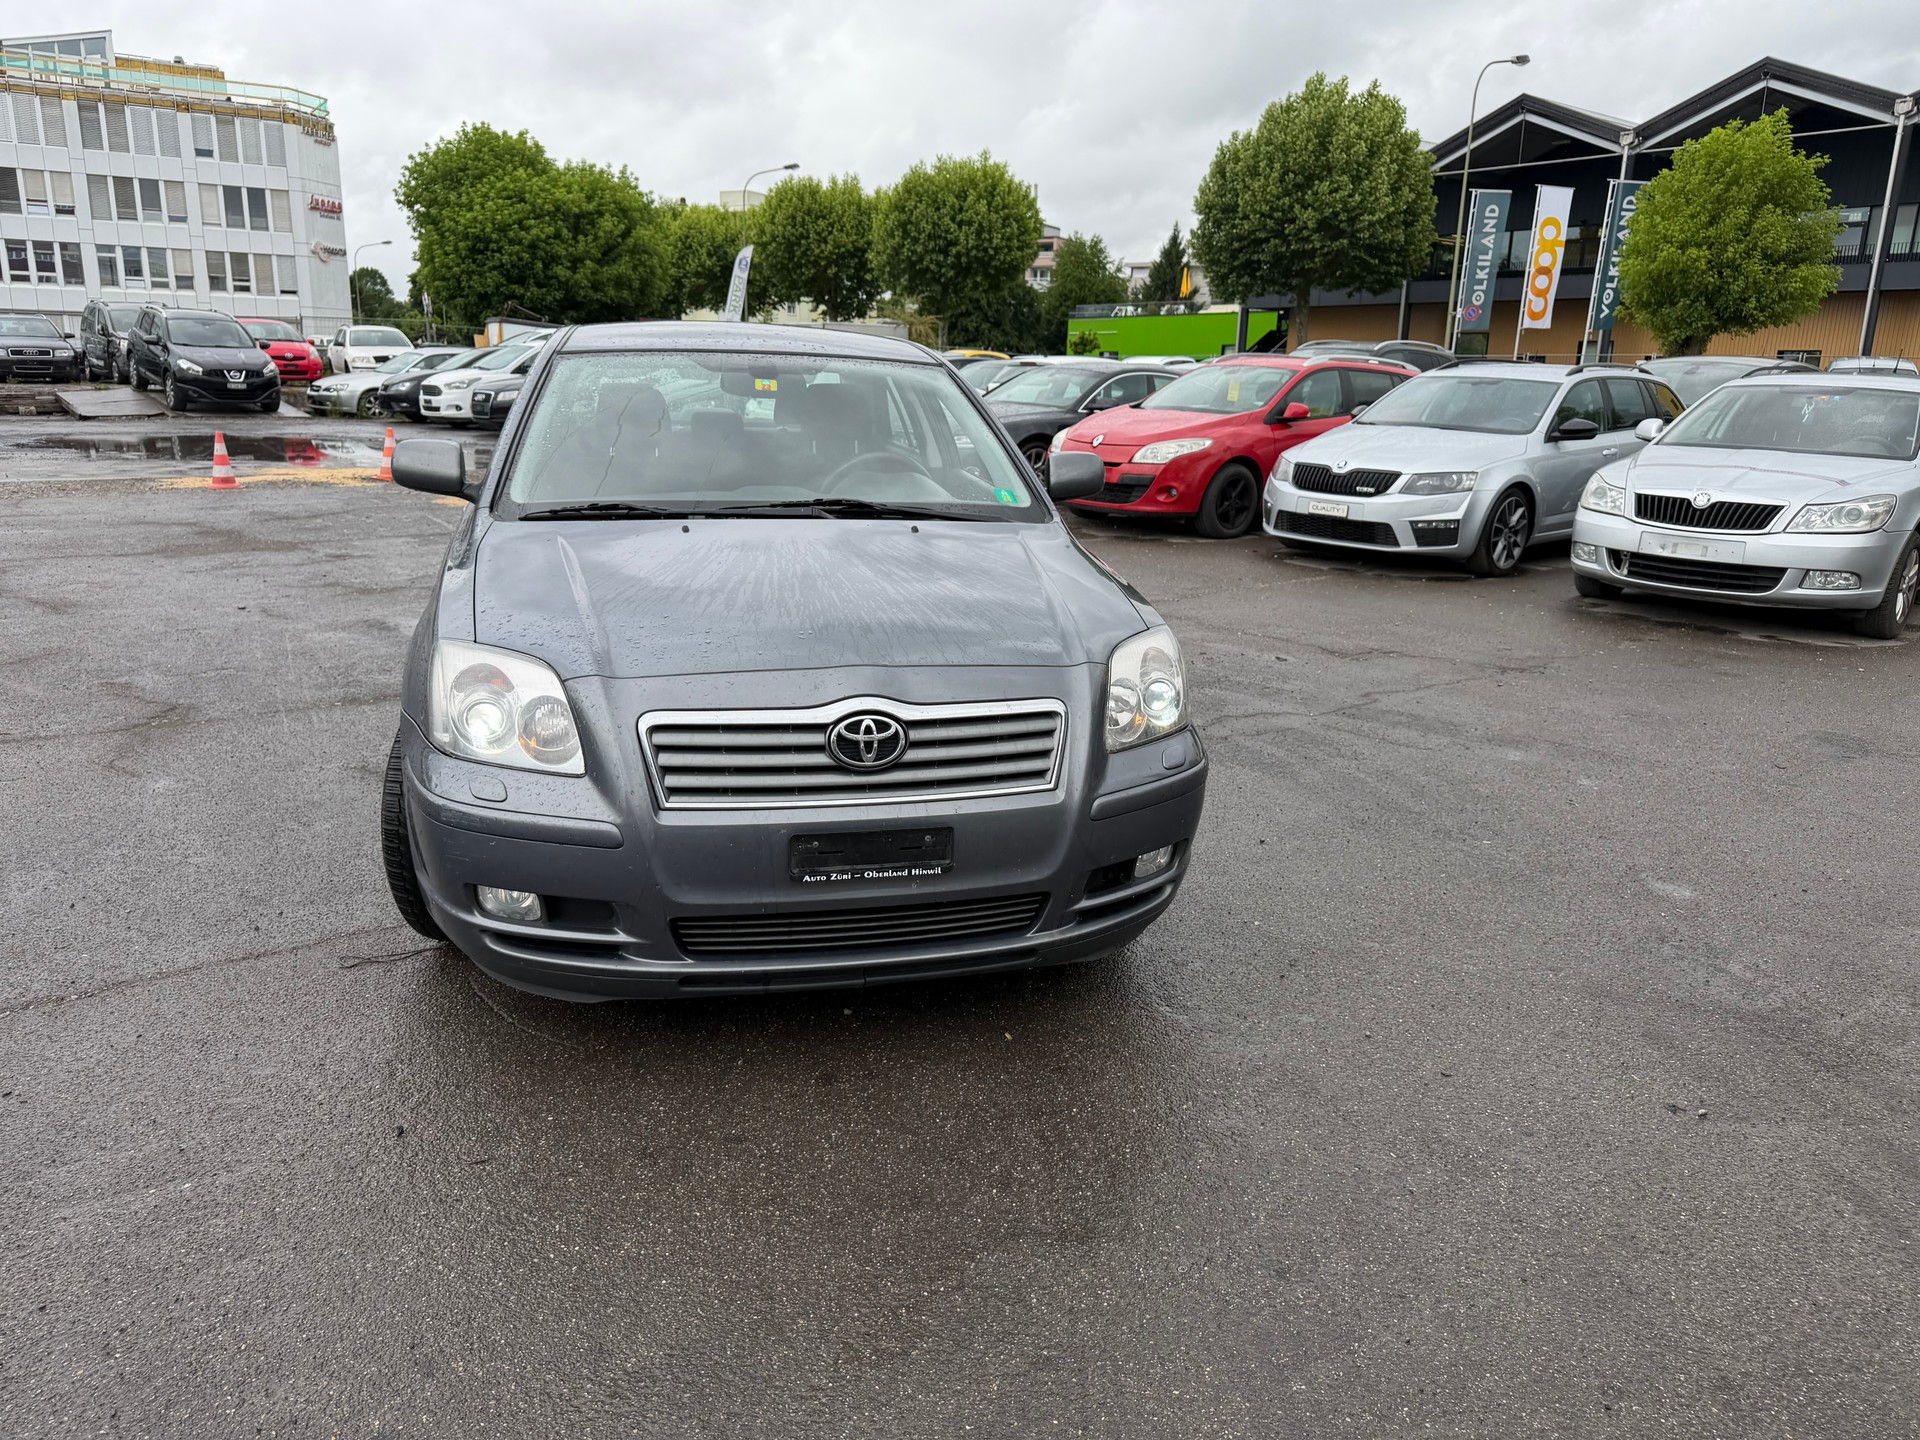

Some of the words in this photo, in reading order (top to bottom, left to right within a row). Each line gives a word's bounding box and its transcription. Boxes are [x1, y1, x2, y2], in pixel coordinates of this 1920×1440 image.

[730, 275, 744, 314] PARK
[1472, 204, 1500, 311] OLKILAND
[1526, 216, 1566, 321] coop
